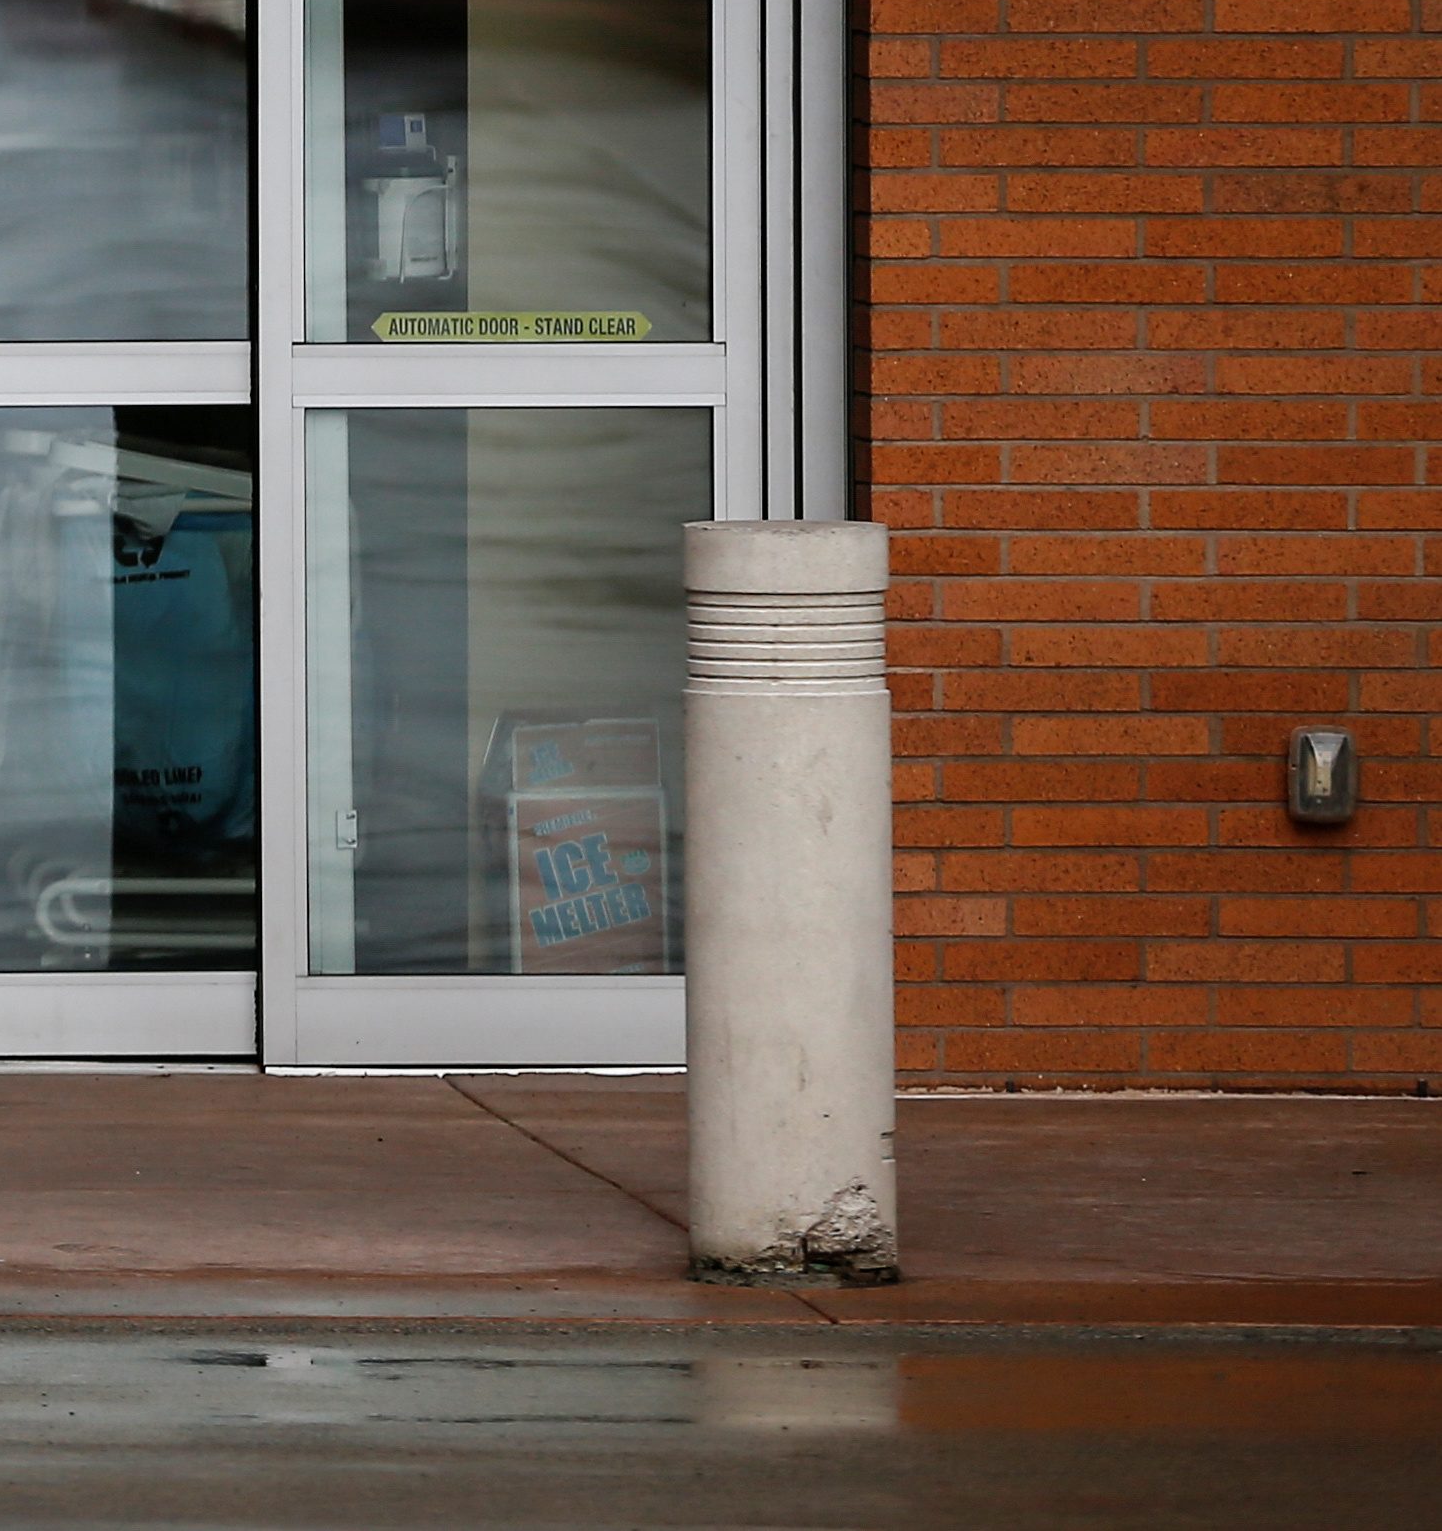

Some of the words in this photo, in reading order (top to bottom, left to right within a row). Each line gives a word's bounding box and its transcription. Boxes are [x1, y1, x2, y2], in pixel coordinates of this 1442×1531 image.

[388, 317, 473, 336] AUTOMATIC
[478, 317, 519, 336] DOOR
[535, 317, 583, 336] STAND
[589, 317, 636, 336] CLEAR
[534, 831, 619, 901] ICE
[529, 884, 652, 948] MELTER
